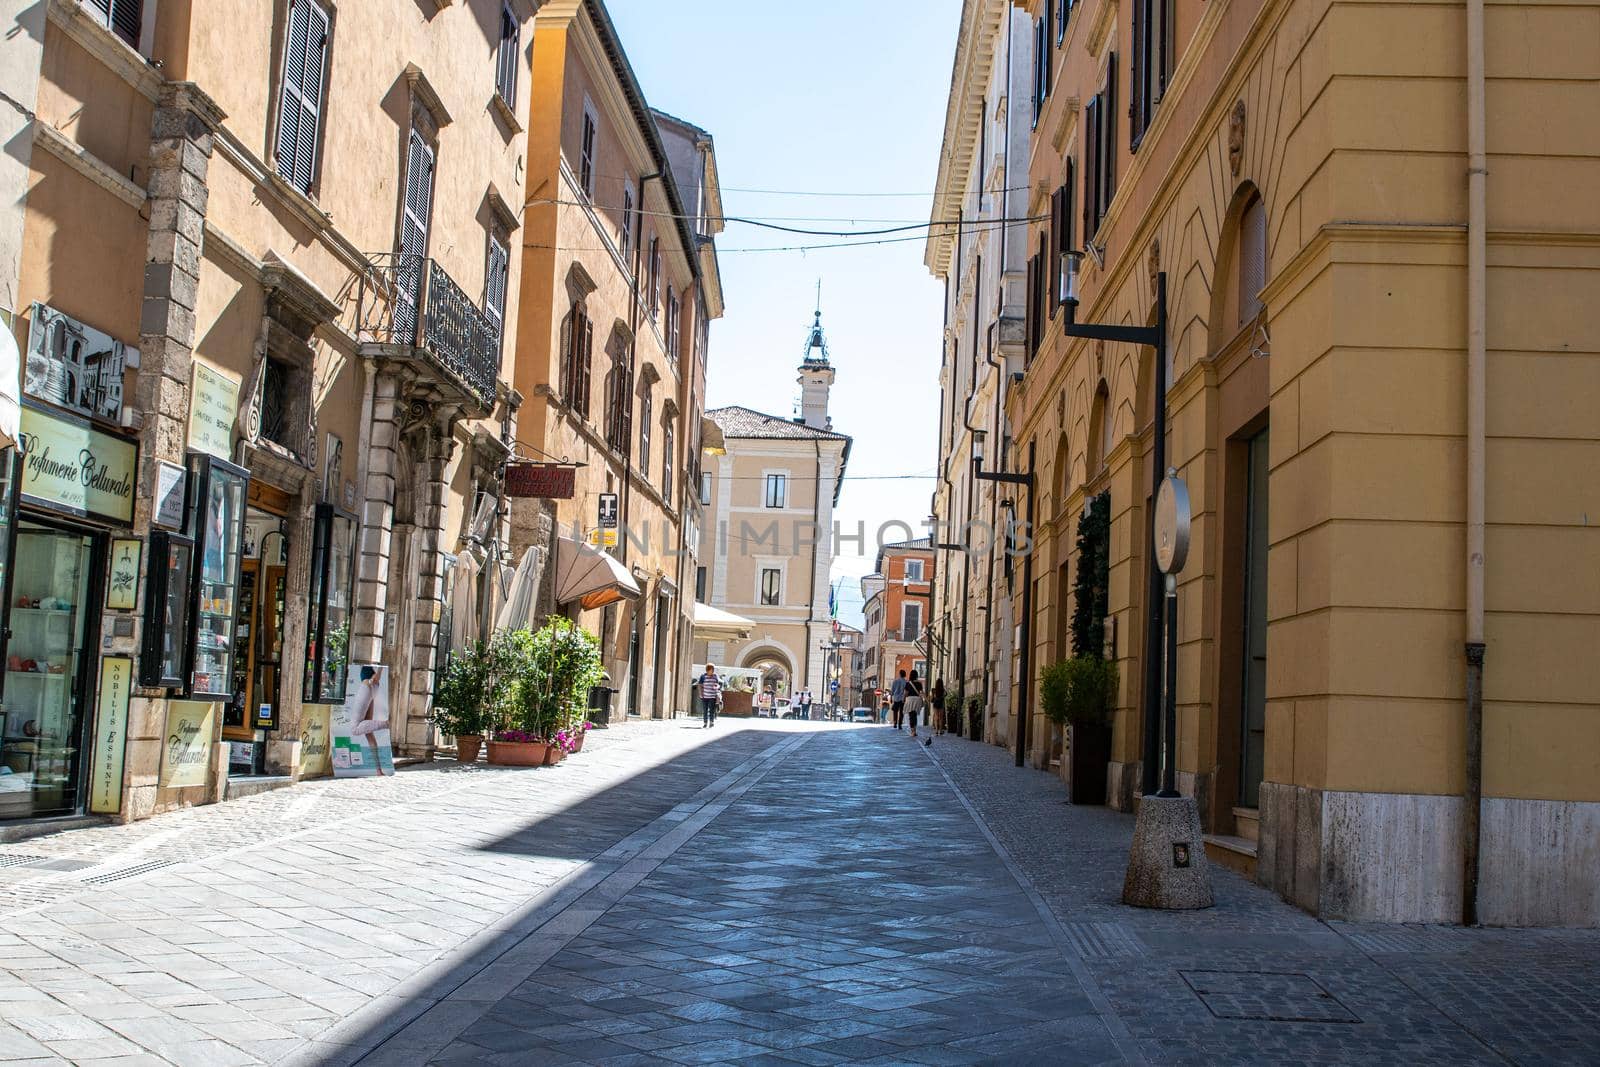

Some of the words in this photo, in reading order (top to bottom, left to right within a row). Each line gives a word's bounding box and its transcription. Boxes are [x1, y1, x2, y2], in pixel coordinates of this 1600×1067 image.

[23, 432, 78, 482] Profumerie
[79, 449, 131, 498] Cellurale
[110, 664, 121, 726] NOBILIS
[103, 731, 117, 807] ESSENTIA
